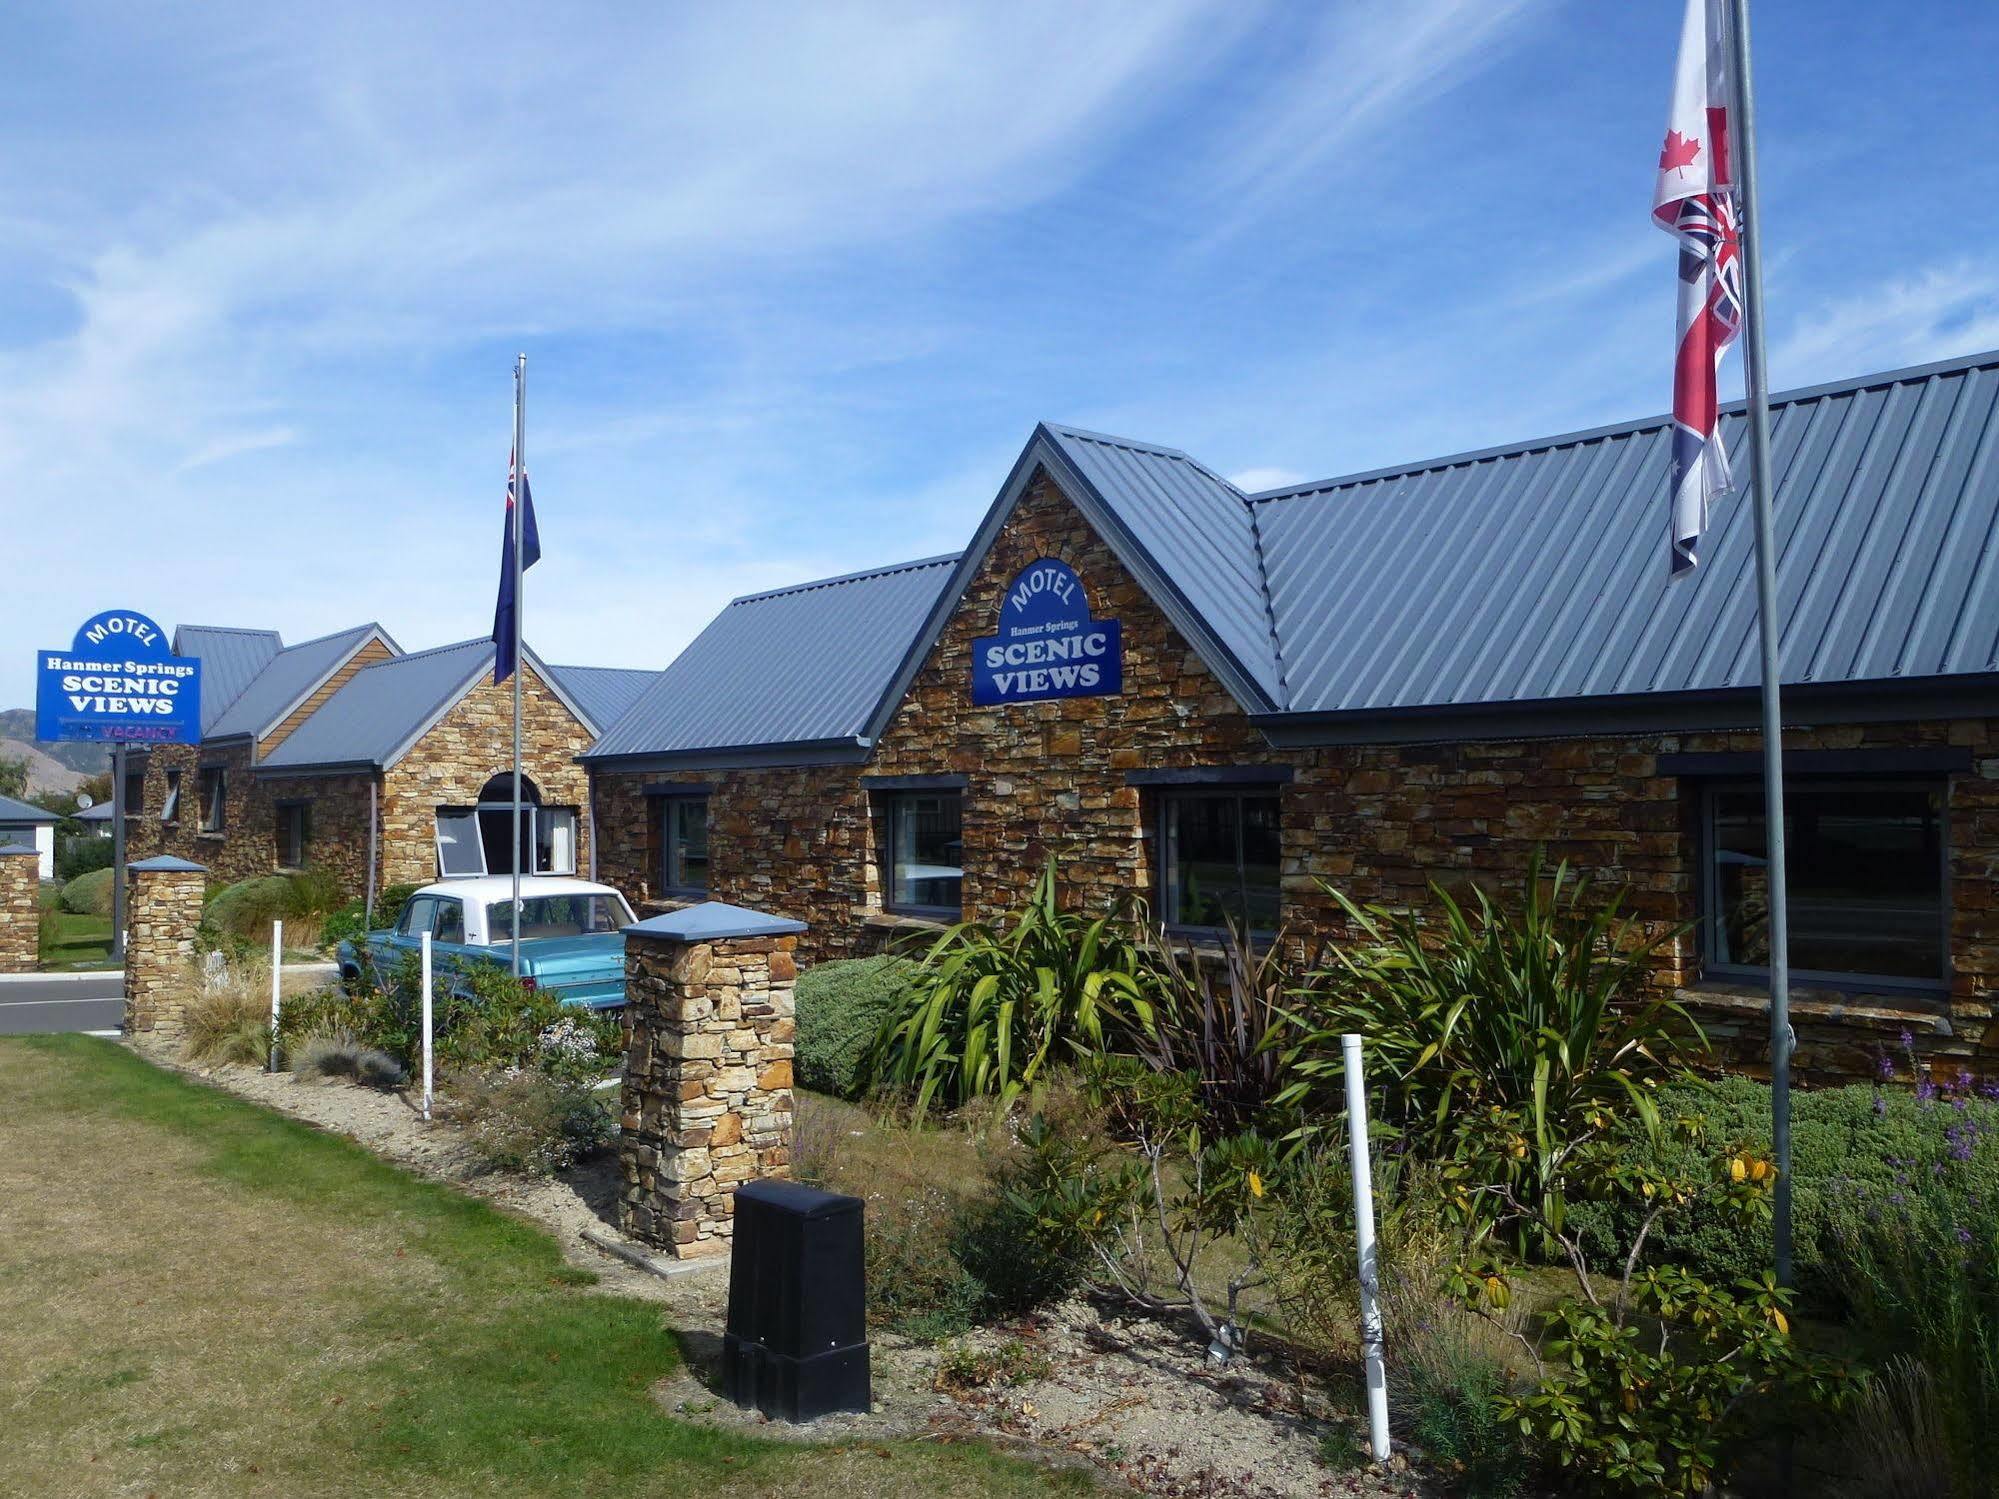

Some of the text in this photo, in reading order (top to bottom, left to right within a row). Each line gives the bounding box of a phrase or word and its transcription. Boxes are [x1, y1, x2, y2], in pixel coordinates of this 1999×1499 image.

[1011, 568, 1075, 613] MOTEL
[86, 618, 158, 647] MOTEL
[1010, 620, 1079, 636] Hanmer Springs
[986, 632, 1107, 668] SCENIC
[47, 657, 194, 678] Hanmer Springs
[62, 675, 179, 696] SCENIC
[992, 663, 1100, 695] VIEWS
[68, 696, 174, 715] VIEWS
[101, 724, 178, 740] VACANCY
